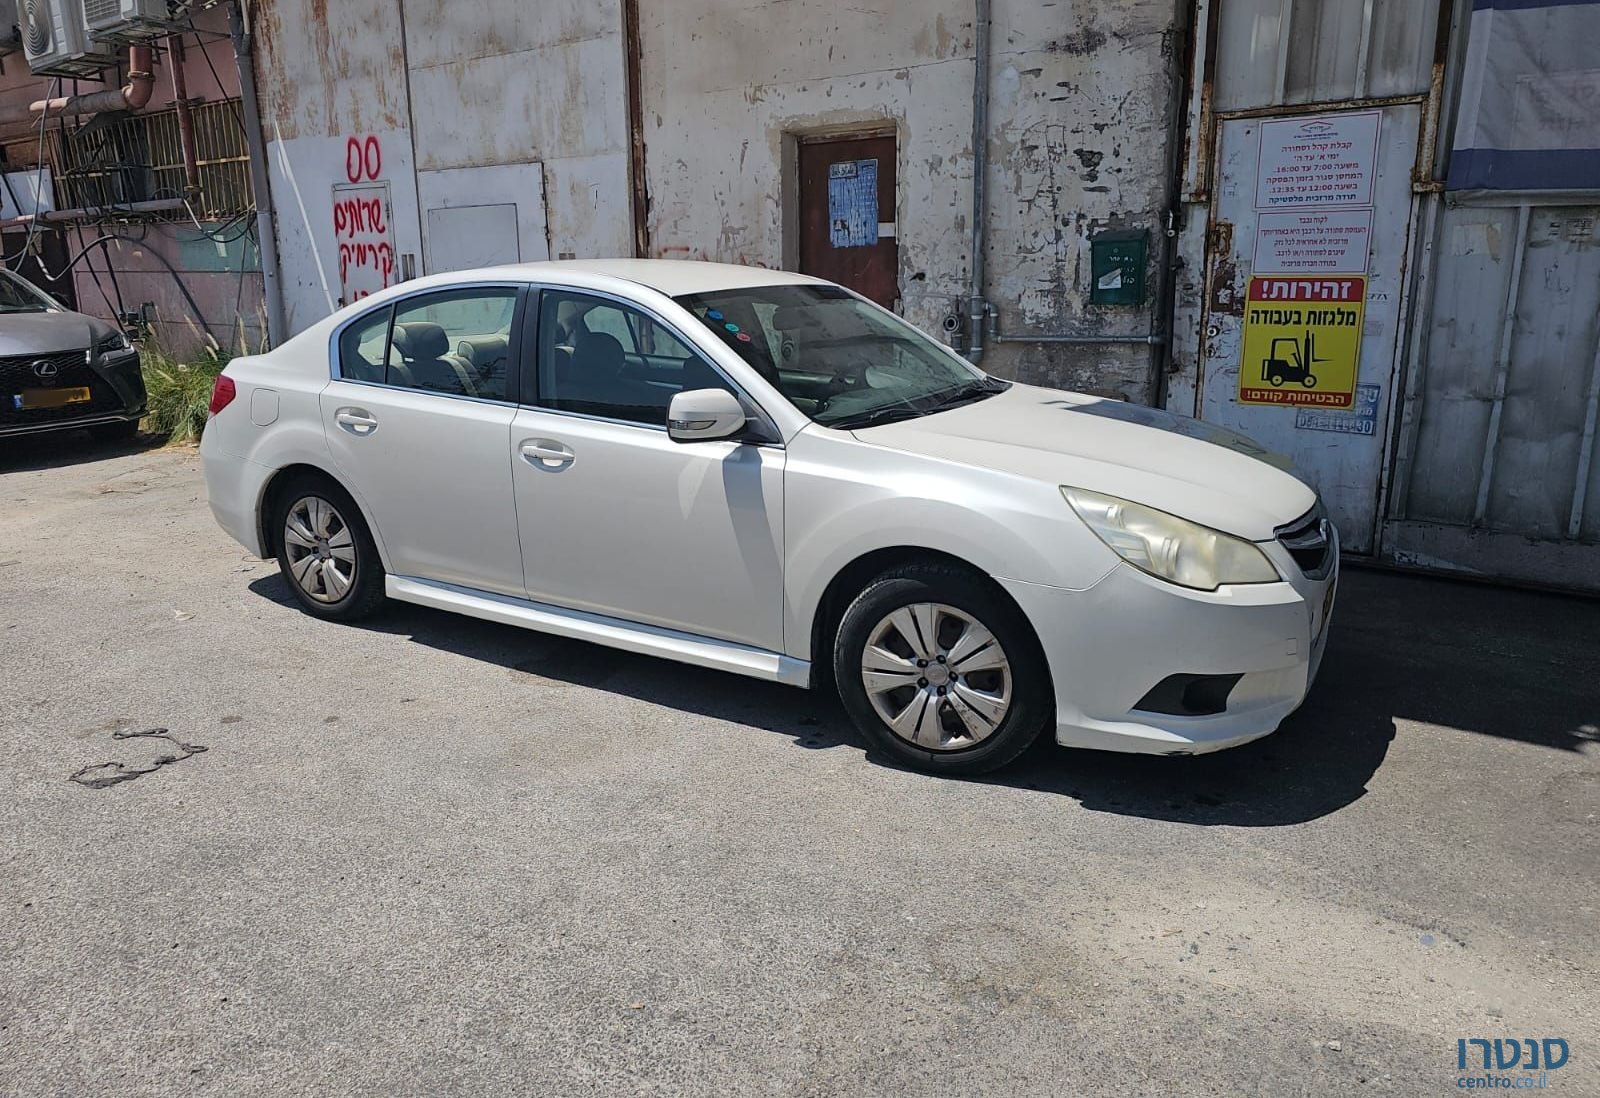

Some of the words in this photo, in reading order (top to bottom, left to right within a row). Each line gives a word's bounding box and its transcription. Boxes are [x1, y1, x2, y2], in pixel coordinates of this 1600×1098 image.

[1312, 143, 1328, 152] קהל
[1330, 142, 1352, 150] קבלת
[1314, 163, 1332, 171] 7:00
[1334, 162, 1359, 170] משעה
[1266, 176, 1294, 185] הפסקה
[1296, 175, 1314, 183] בזמן
[1336, 172, 1362, 181] המחסן
[1268, 195, 1303, 204] פלסטיקה
[334, 198, 386, 239] שרותים
[1314, 216, 1328, 224] לקוח
[1262, 280, 1352, 299] זהירות!
[1250, 309, 1302, 326] בעבודה
[1305, 307, 1357, 326] מלגזות
[1247, 389, 1283, 401] קודם!
[1286, 392, 1345, 404] הבטיחות
